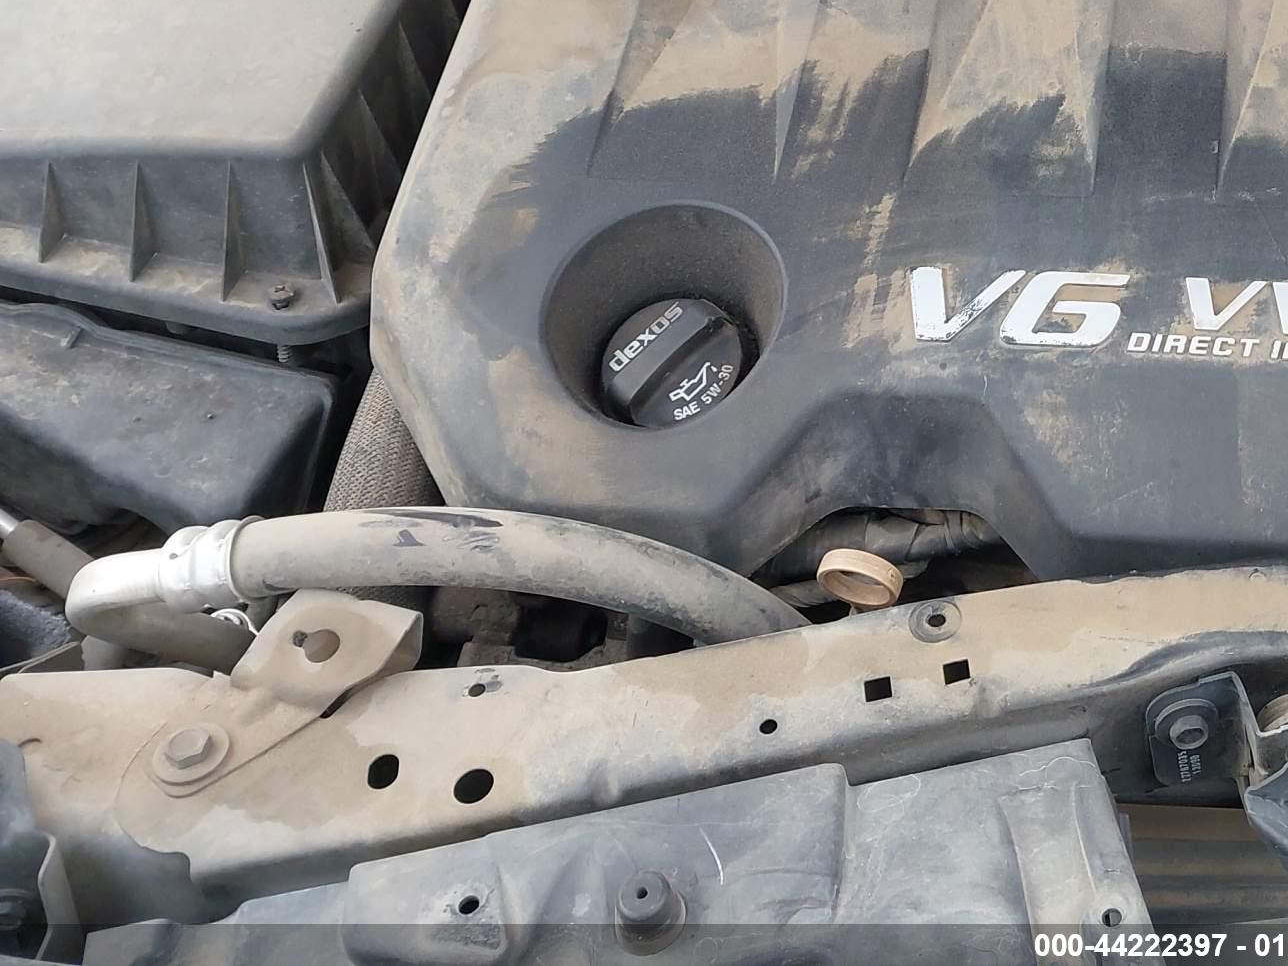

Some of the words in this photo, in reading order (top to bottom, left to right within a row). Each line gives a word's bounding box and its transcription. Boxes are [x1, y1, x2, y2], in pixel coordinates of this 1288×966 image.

[608, 301, 684, 372] dexos
[910, 266, 1131, 346] V6
[1127, 332, 1260, 357] DIRECT
[673, 402, 700, 420] SAE
[700, 364, 734, 405] 5W-30
